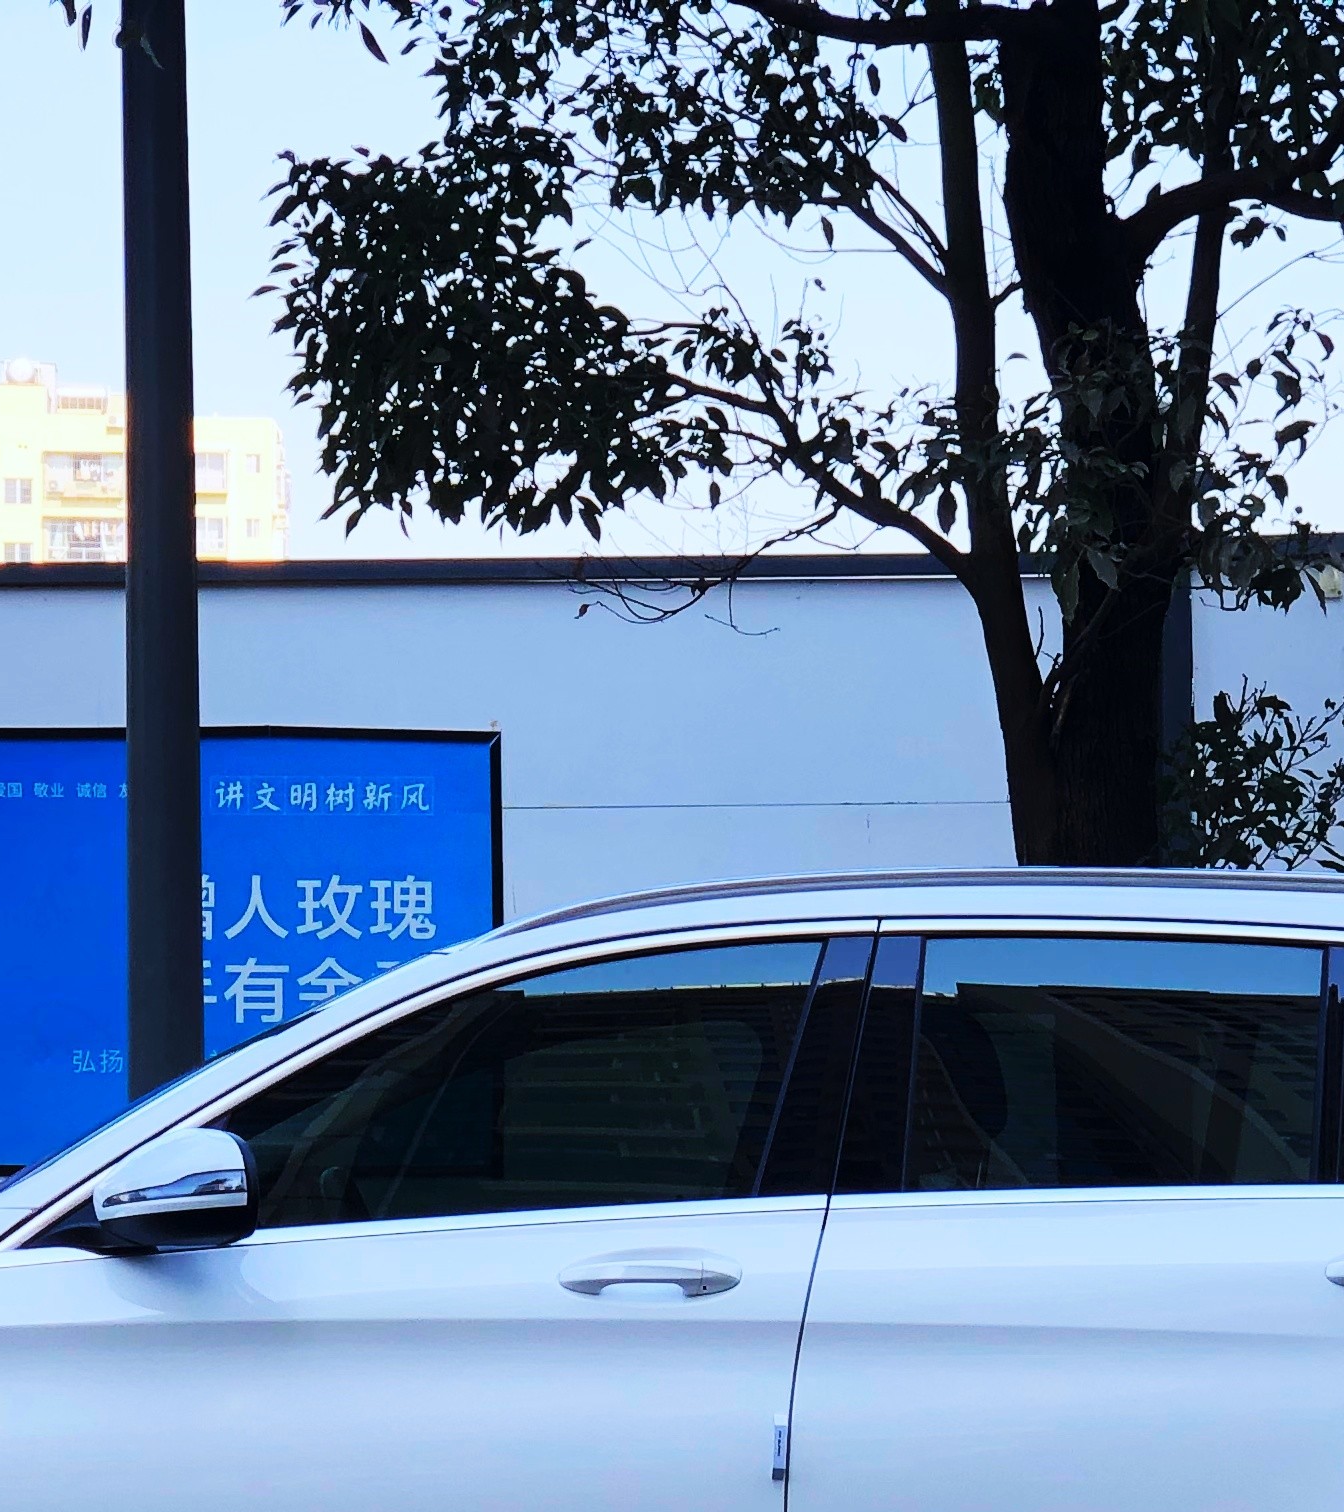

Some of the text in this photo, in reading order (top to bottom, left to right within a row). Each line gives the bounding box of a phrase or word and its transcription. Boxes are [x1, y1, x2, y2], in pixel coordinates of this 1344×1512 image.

[34, 783, 64, 797] 敬业
[77, 783, 106, 798] 诚信
[215, 780, 431, 812] 讲文明树新风
[202, 874, 436, 941] 人玫瑰
[203, 957, 399, 1024] 有余
[72, 1049, 123, 1073] 弘扬
